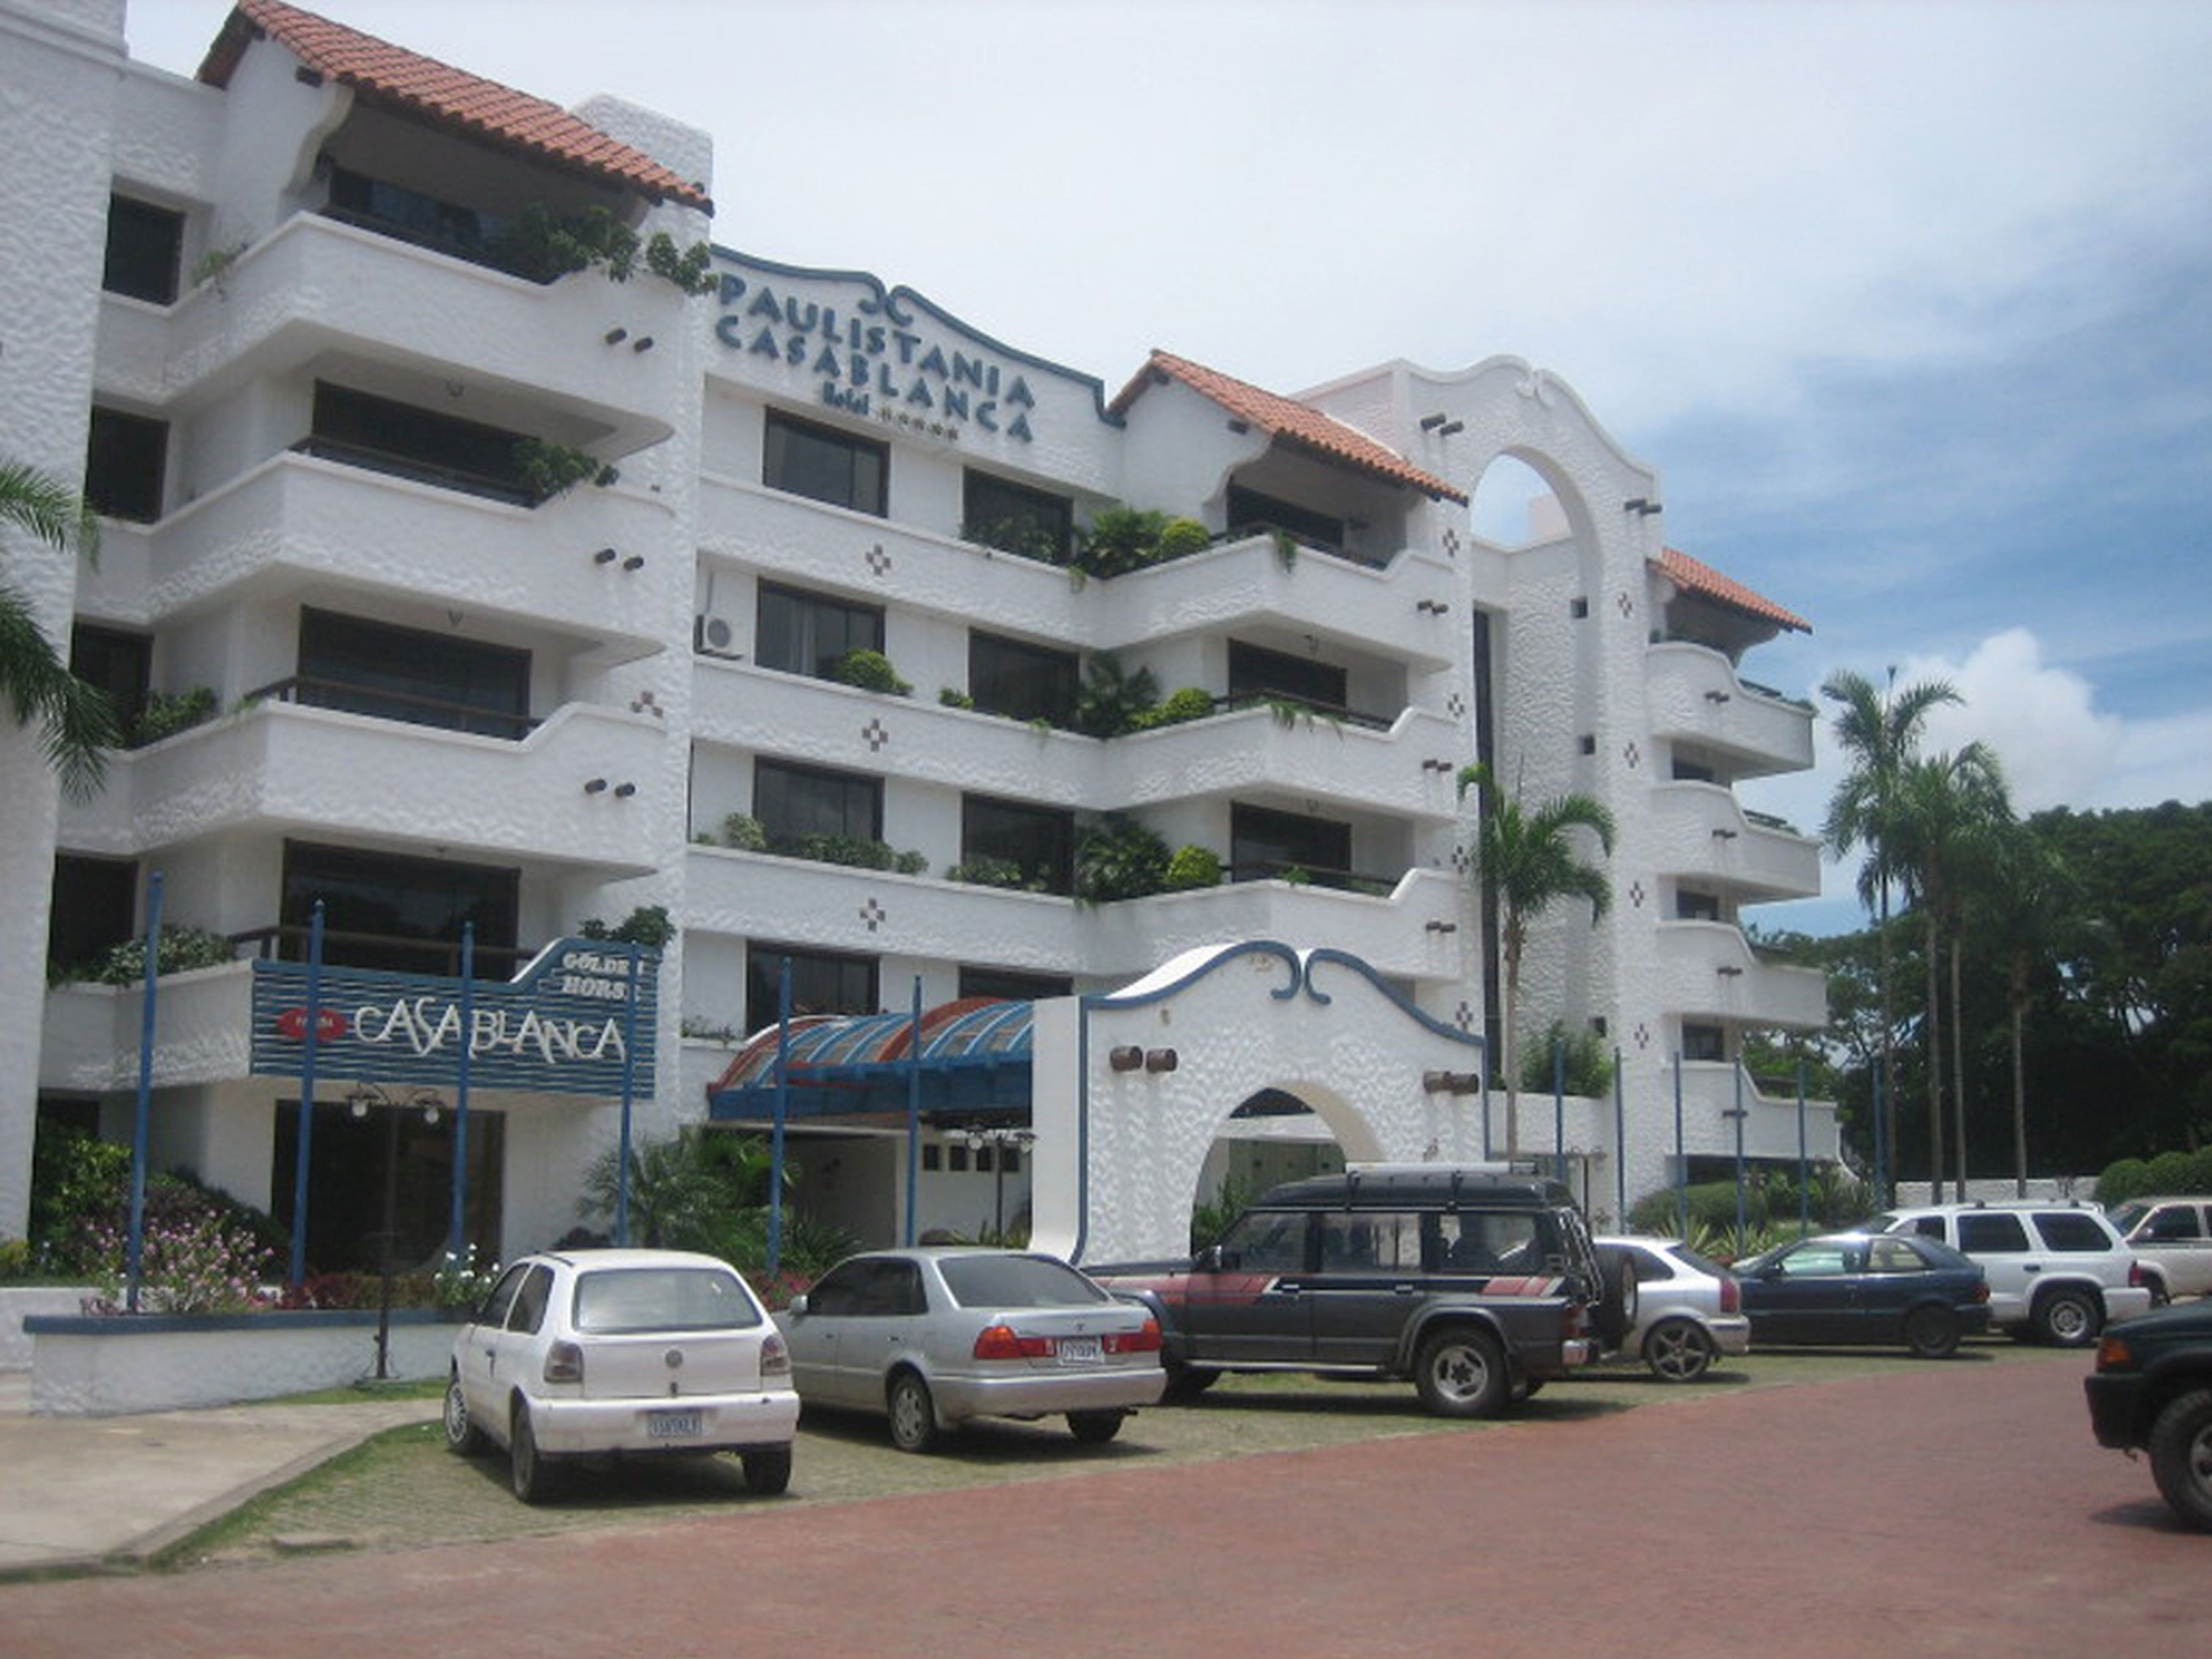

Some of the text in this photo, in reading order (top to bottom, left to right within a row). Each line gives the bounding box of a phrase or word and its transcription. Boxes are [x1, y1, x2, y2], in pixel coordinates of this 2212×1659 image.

[715, 315, 1033, 443] CASABLANCA
[720, 272, 1035, 409] PAULISTANIA
[354, 997, 627, 1063] CASABLANCA
